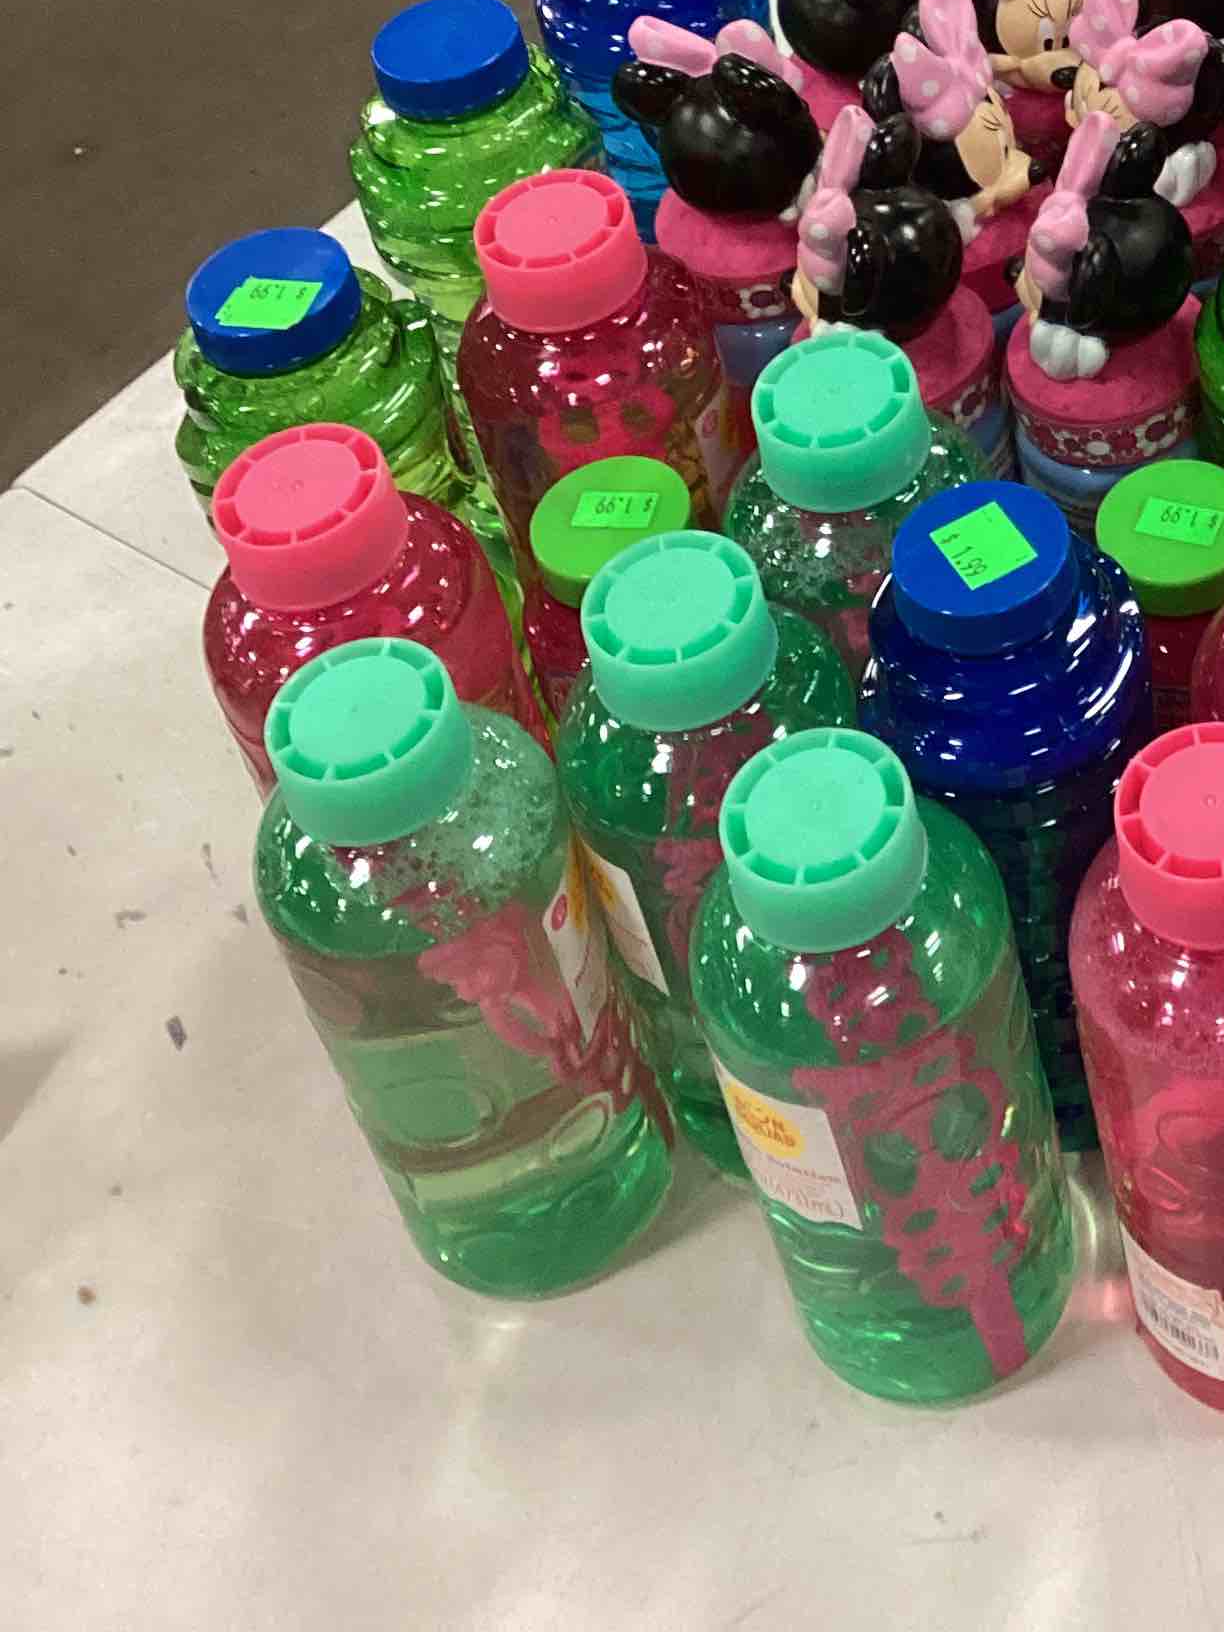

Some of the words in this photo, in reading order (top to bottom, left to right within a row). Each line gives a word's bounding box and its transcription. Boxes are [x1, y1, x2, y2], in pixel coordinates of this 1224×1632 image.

[594, 495, 633, 515] 1.99
[1159, 505, 1199, 527] 1.99
[950, 545, 989, 577] 1.99
